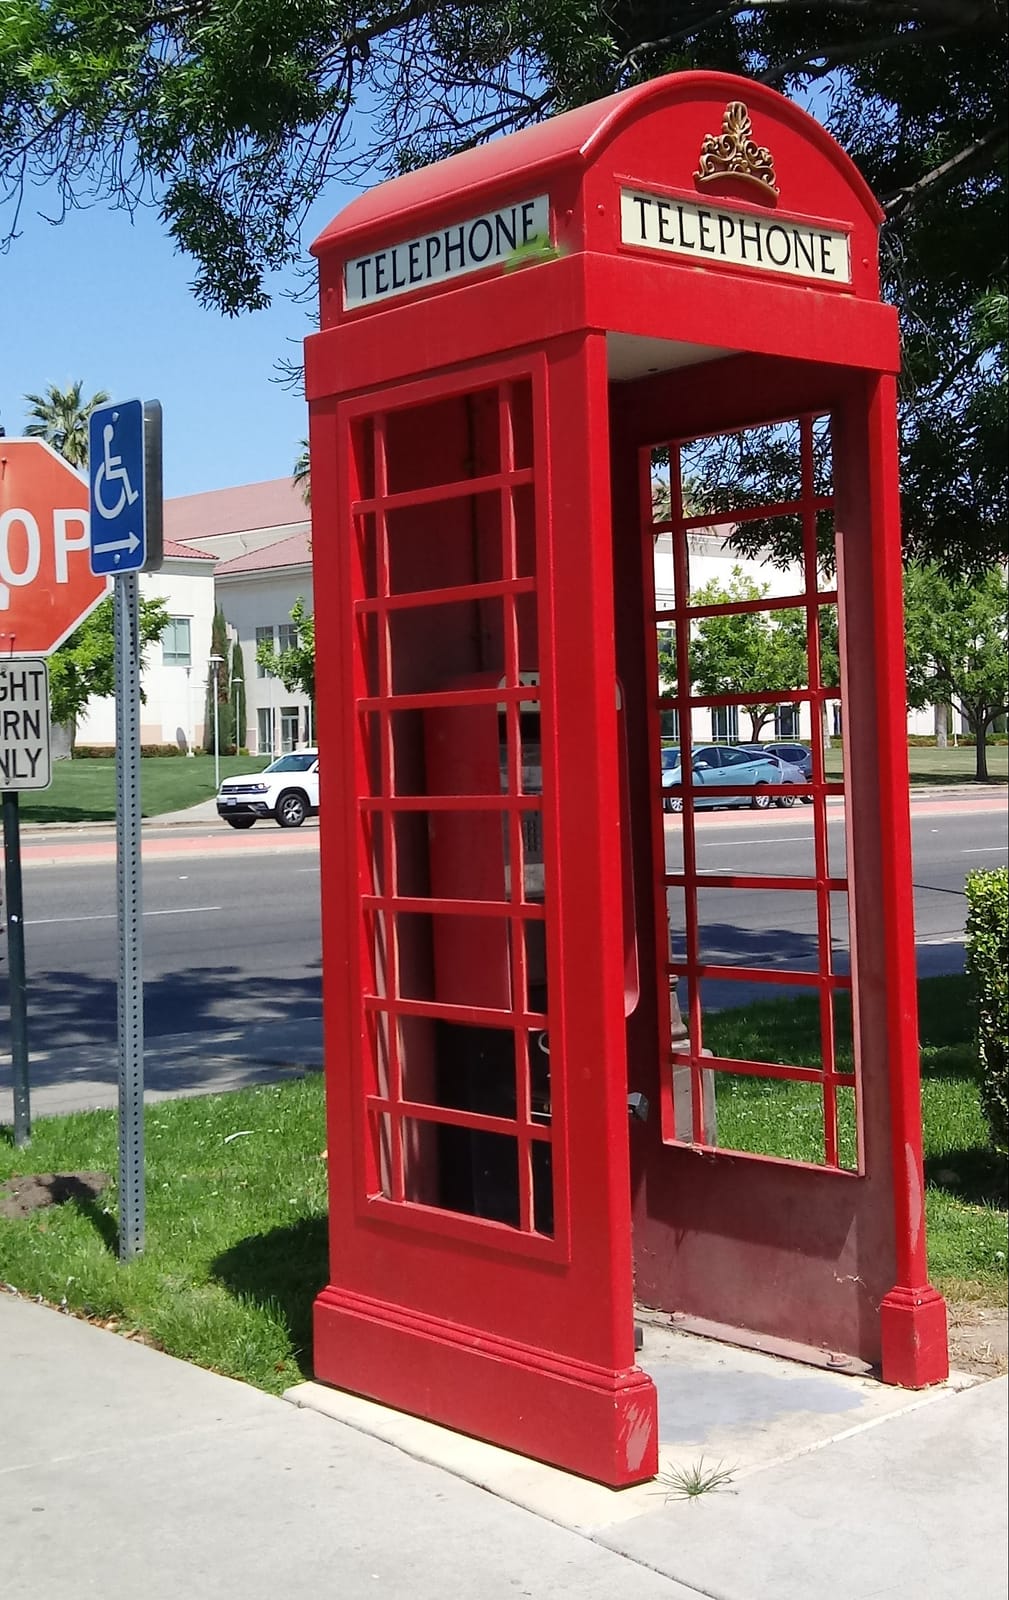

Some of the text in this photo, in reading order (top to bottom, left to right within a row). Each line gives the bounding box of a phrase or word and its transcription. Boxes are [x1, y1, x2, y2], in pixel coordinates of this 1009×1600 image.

[356, 201, 538, 299] TELEPHONE
[634, 197, 836, 275] TELEPHONE
[0, 508, 90, 586] OP
